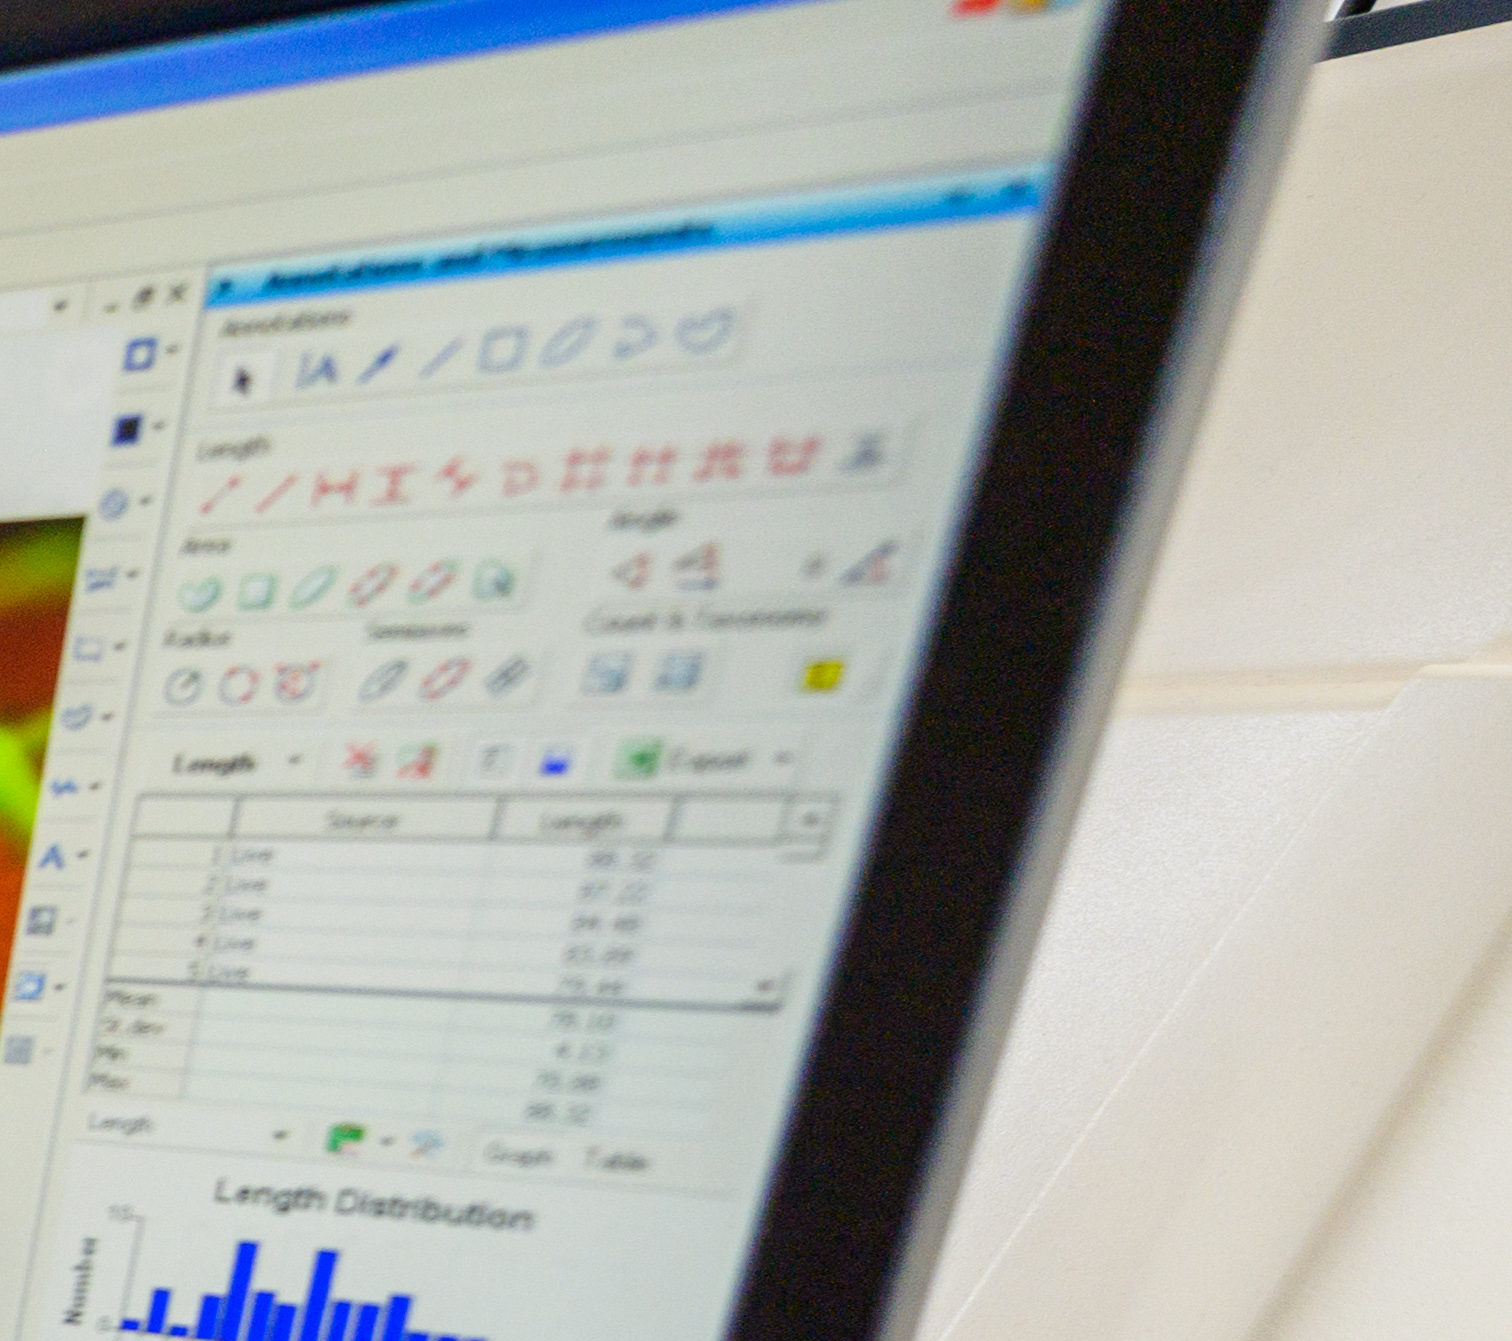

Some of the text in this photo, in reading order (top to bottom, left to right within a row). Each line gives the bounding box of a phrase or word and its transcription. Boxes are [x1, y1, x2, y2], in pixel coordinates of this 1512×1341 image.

[172, 751, 257, 777] Length
[213, 1177, 536, 1231] Length Distribution
[63, 1237, 99, 1328] Number
